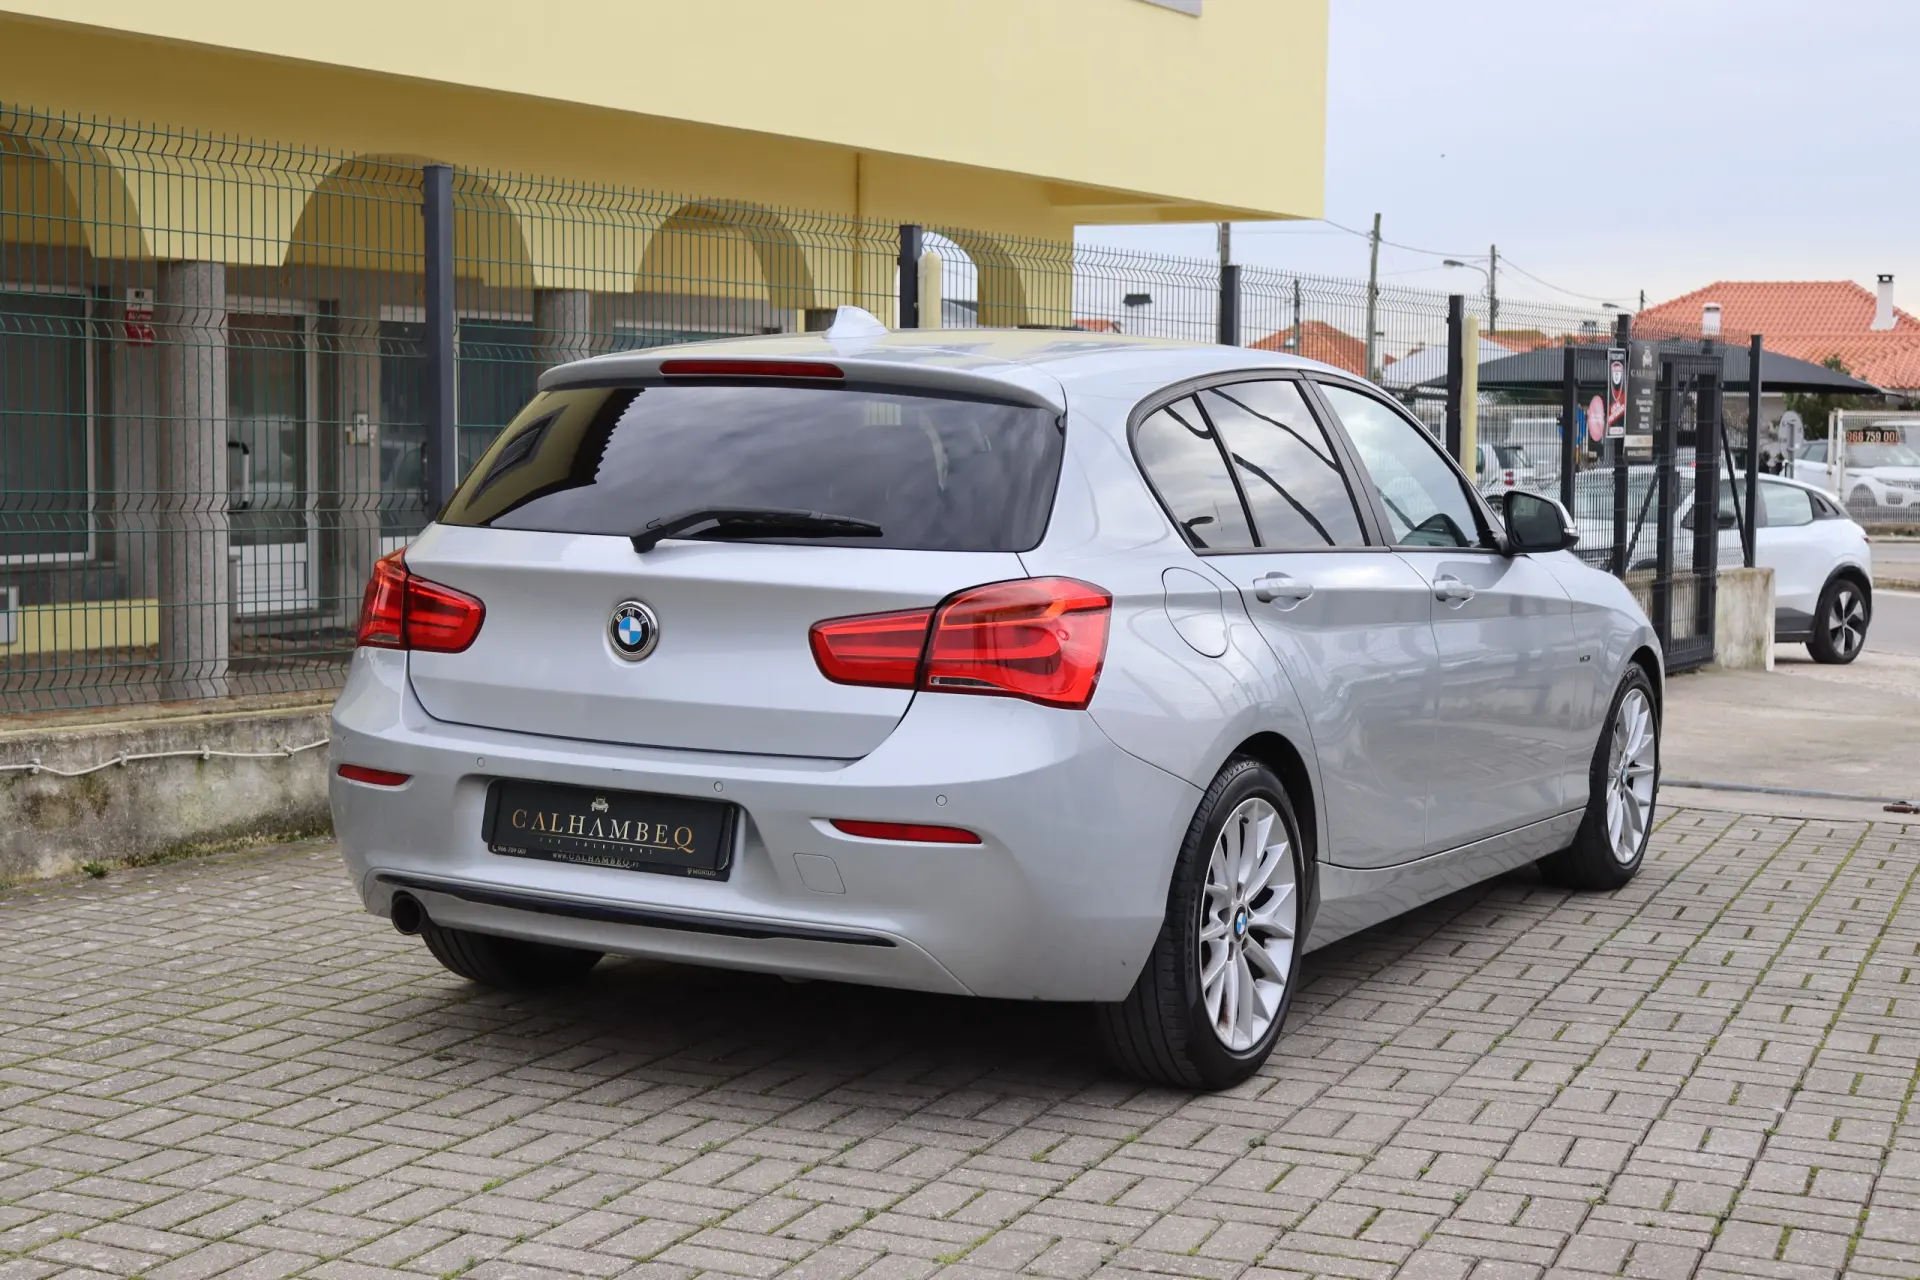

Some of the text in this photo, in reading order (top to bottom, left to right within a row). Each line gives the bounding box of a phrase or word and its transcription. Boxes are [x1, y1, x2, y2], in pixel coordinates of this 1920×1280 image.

[1866, 430, 1881, 442] 759
[615, 608, 648, 625] BMW
[512, 808, 695, 853] CALHAMBEQ
